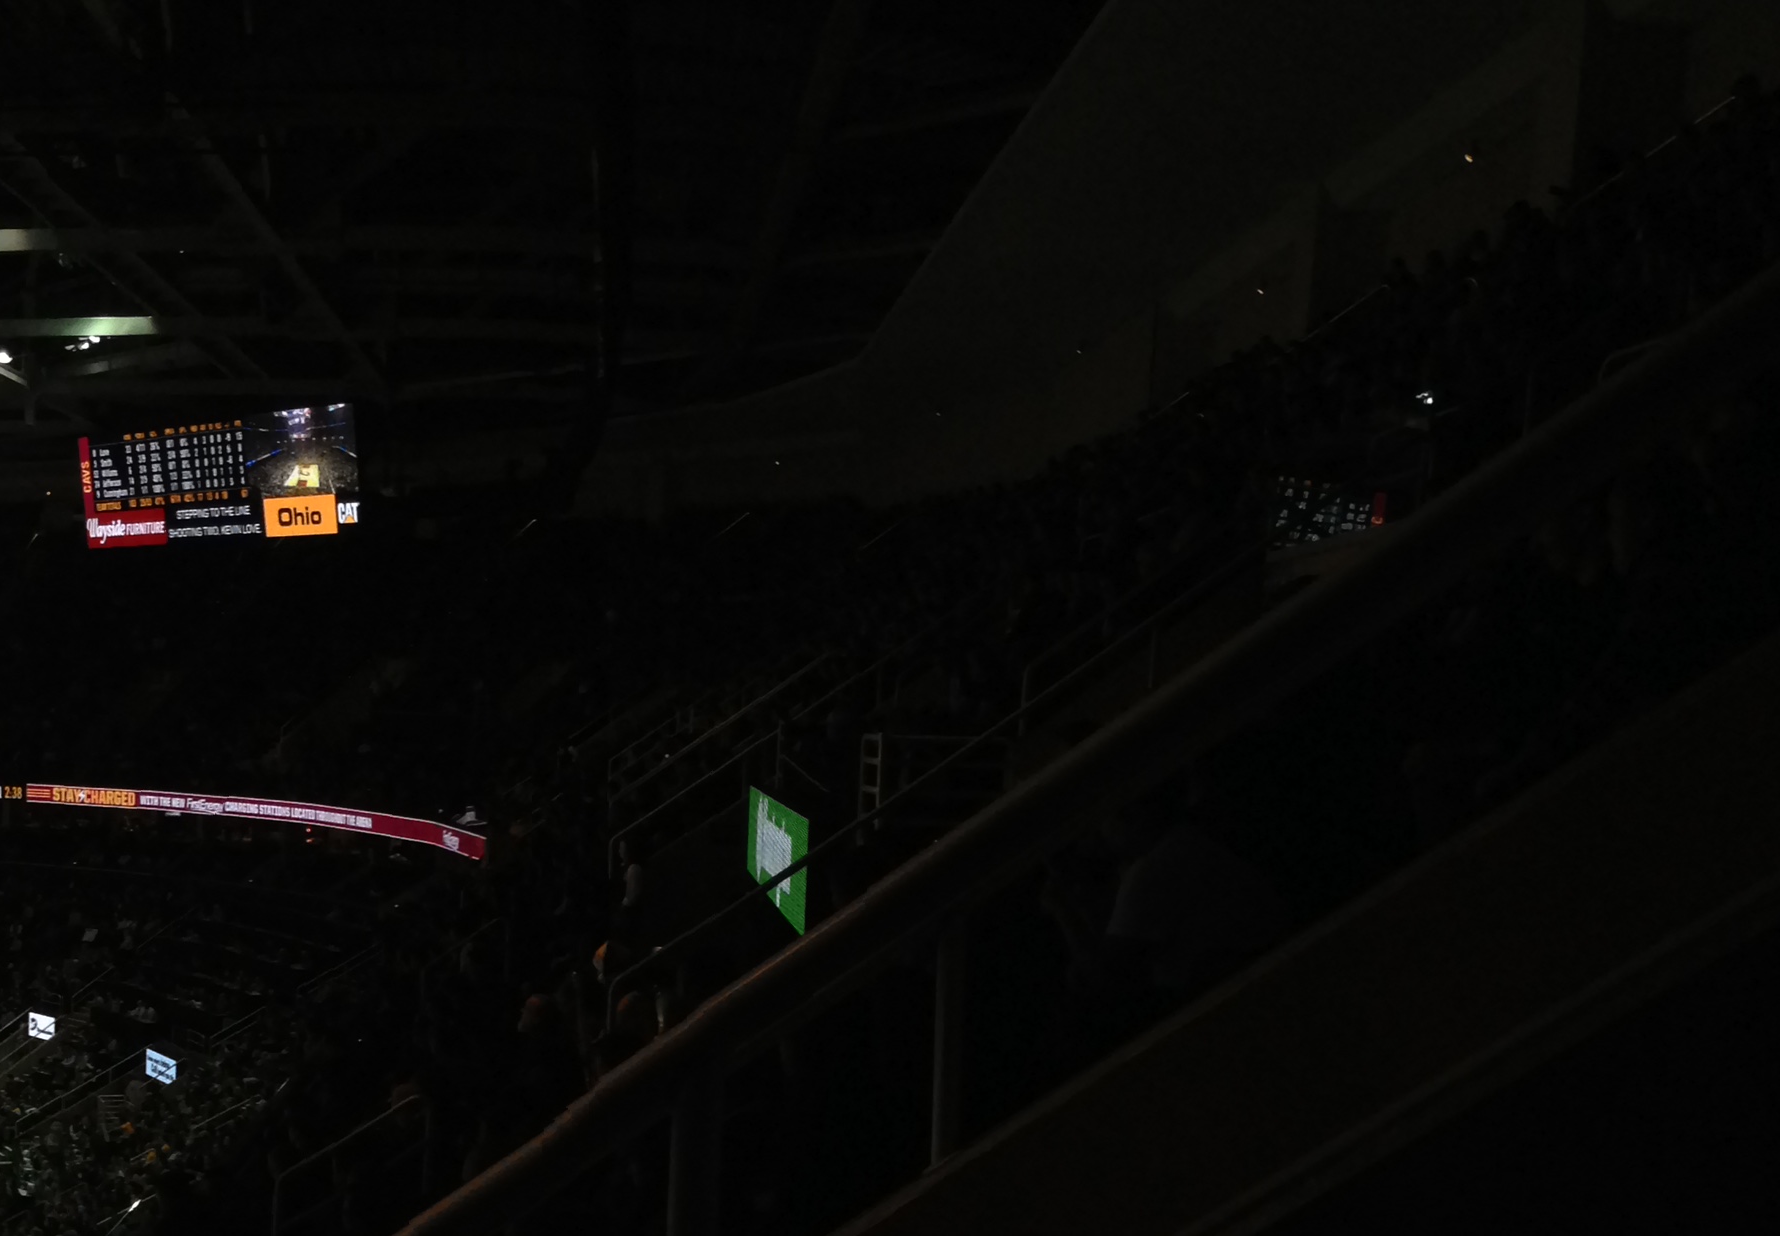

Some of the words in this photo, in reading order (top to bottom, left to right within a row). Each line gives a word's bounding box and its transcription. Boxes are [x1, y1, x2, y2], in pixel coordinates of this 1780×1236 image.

[277, 507, 322, 527] Ohio
[337, 502, 360, 524] CAT
[87, 517, 126, 544] Wayside
[126, 520, 165, 536] FURNITURE
